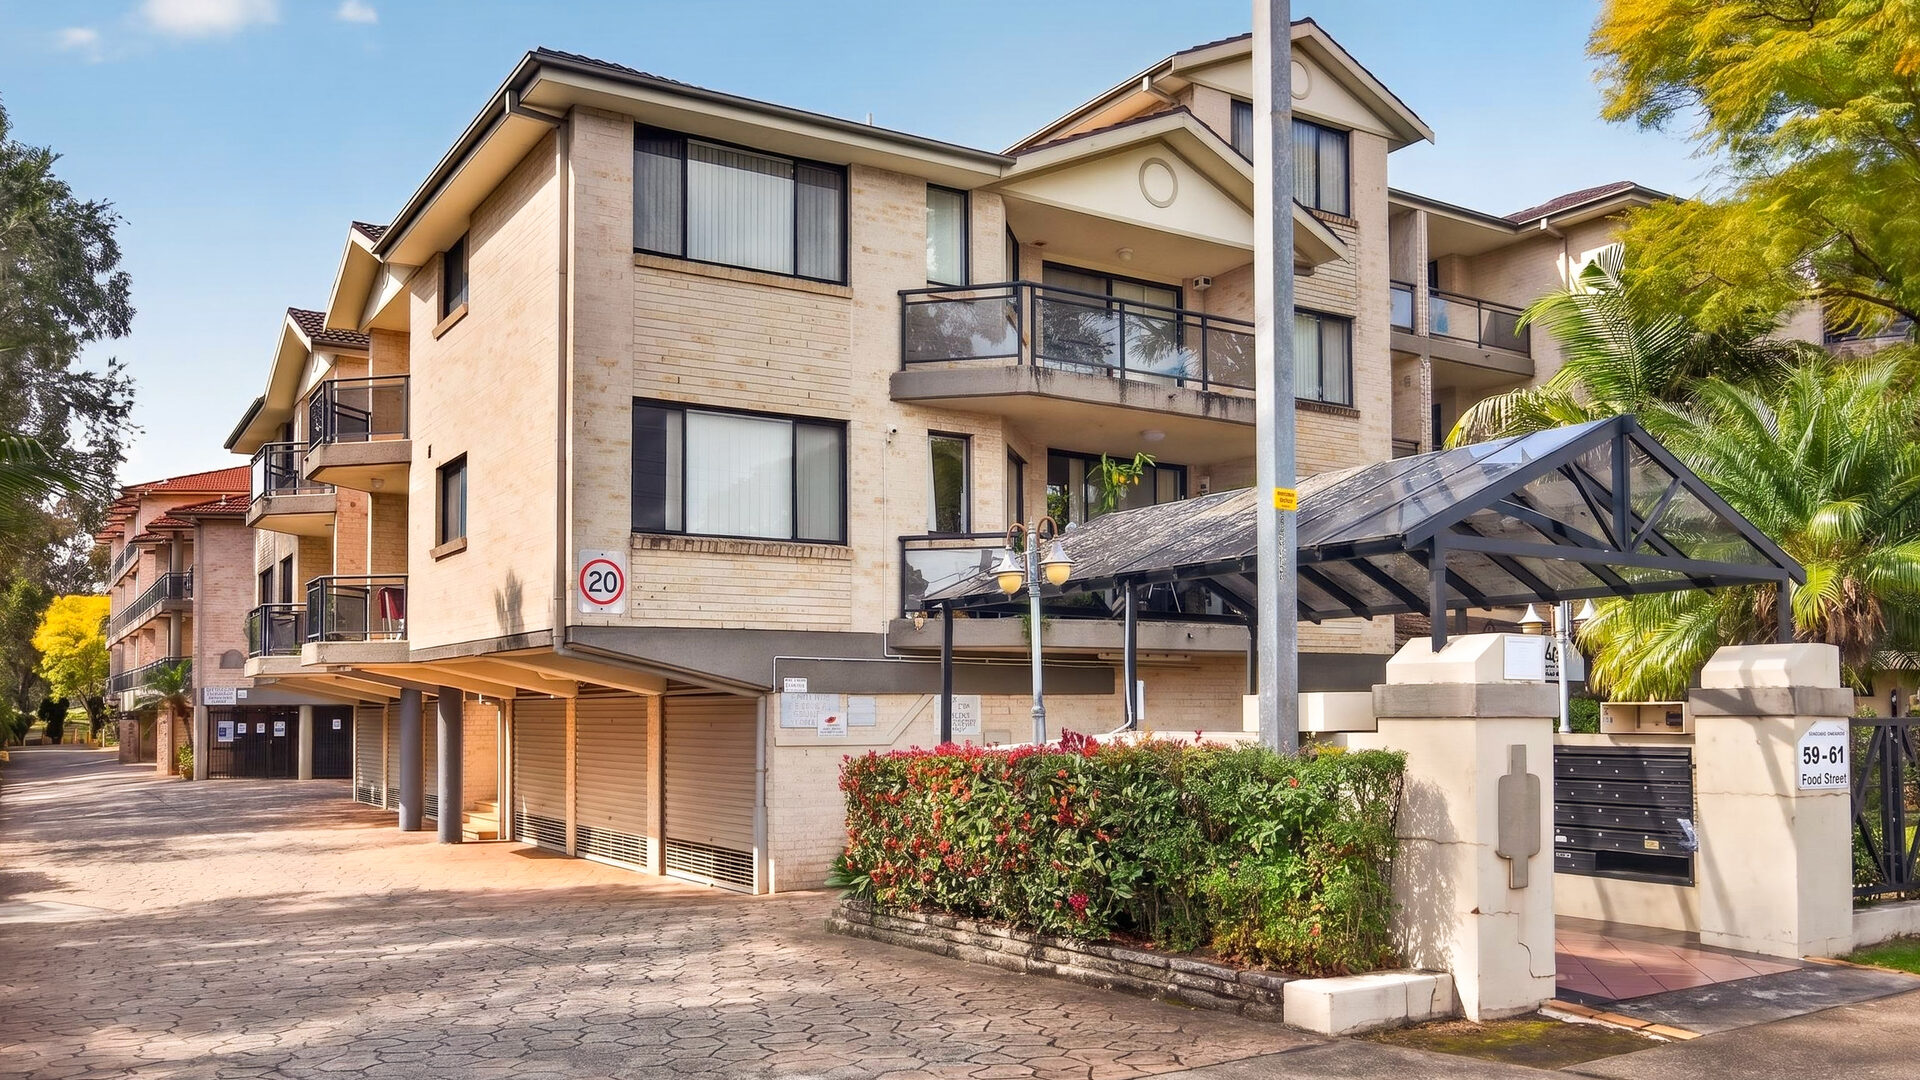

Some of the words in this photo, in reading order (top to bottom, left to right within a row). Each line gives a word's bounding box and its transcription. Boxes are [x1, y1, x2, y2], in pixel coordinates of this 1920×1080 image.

[588, 570, 618, 593] 20
[1802, 773, 1822, 785] Food
[1824, 772, 1847, 785] Street
